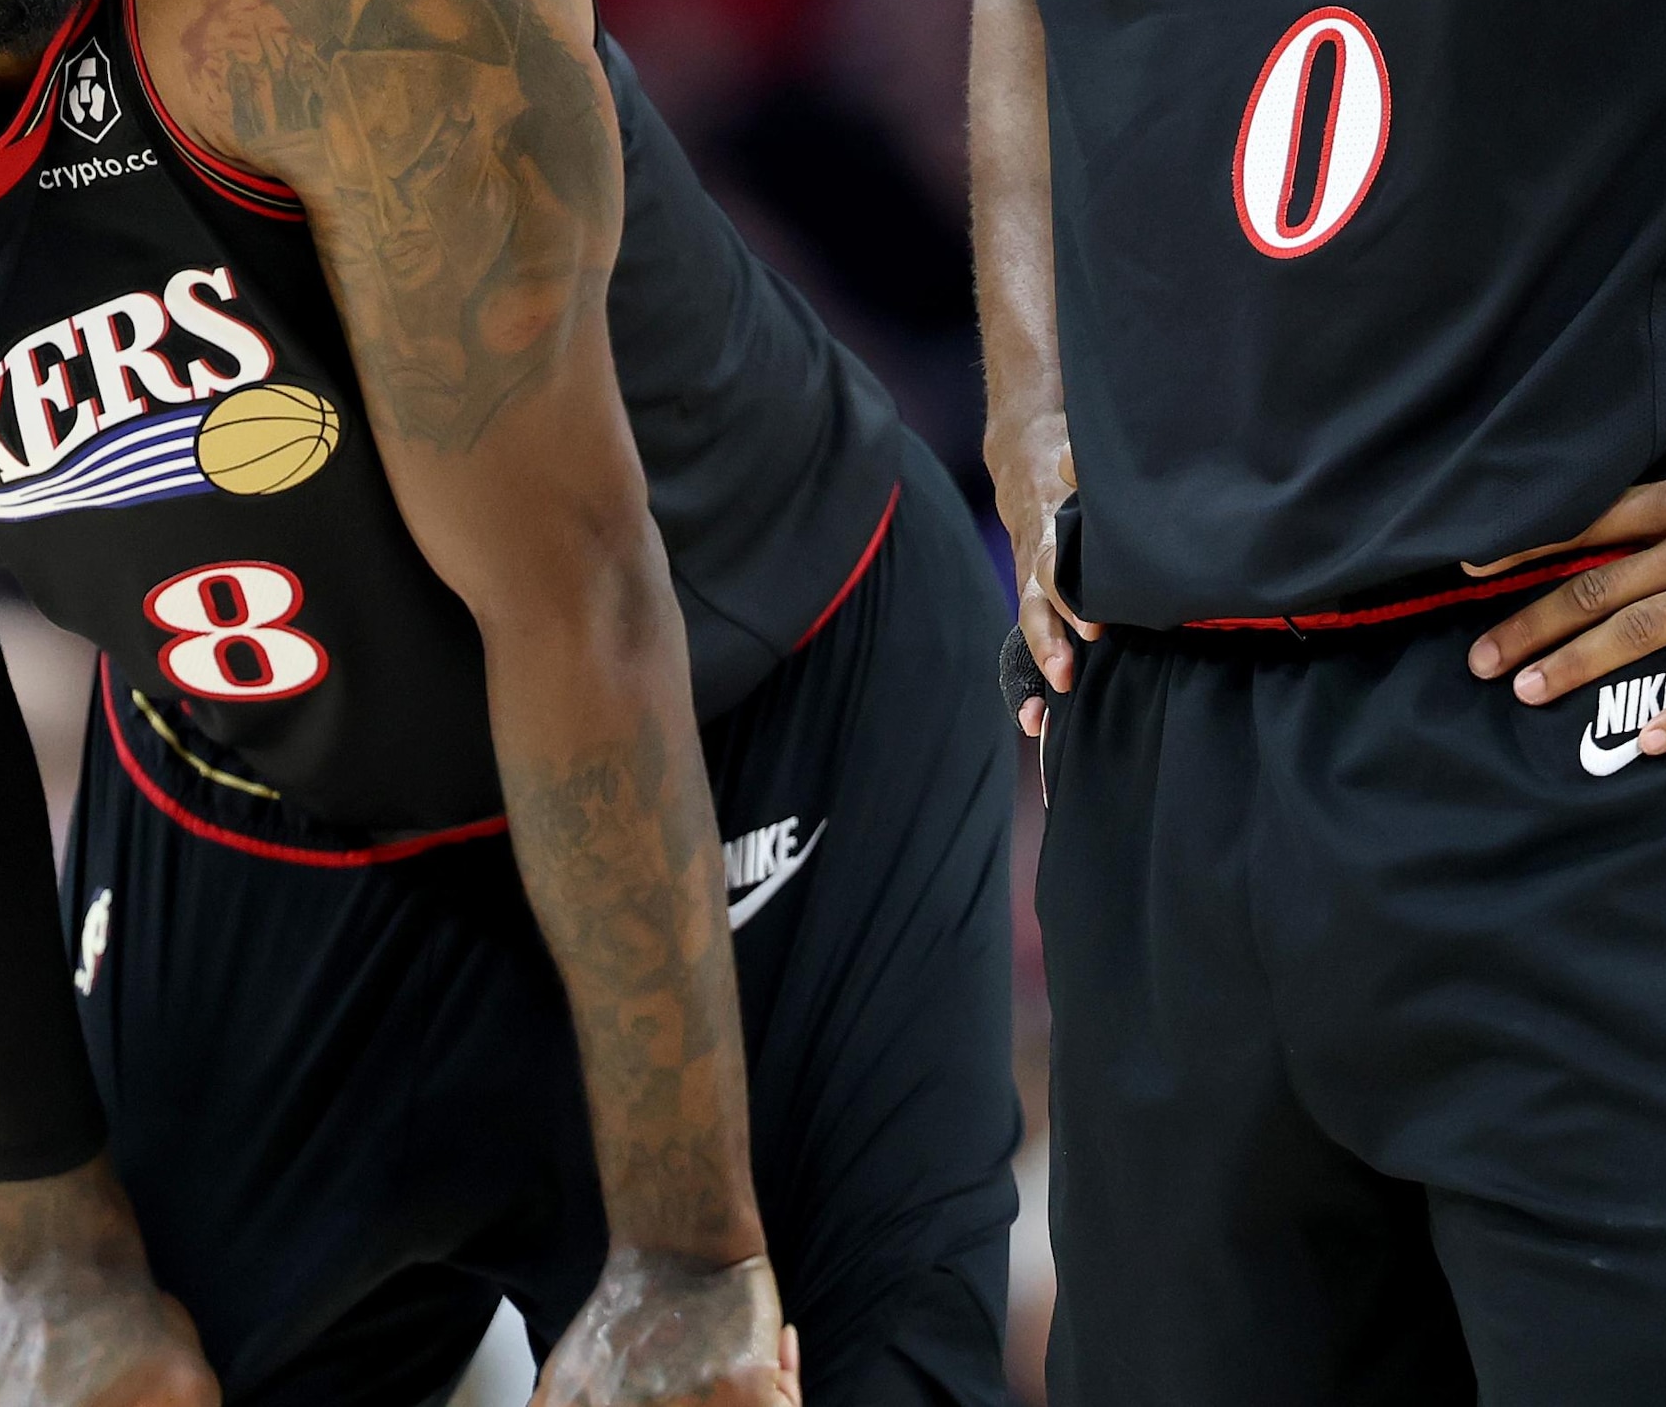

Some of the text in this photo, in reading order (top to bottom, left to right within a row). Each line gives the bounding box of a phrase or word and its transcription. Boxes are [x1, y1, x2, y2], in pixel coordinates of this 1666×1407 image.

[38, 148, 158, 189] crypto.co
[1231, 5, 1391, 259] 0
[142, 559, 329, 702] 8
